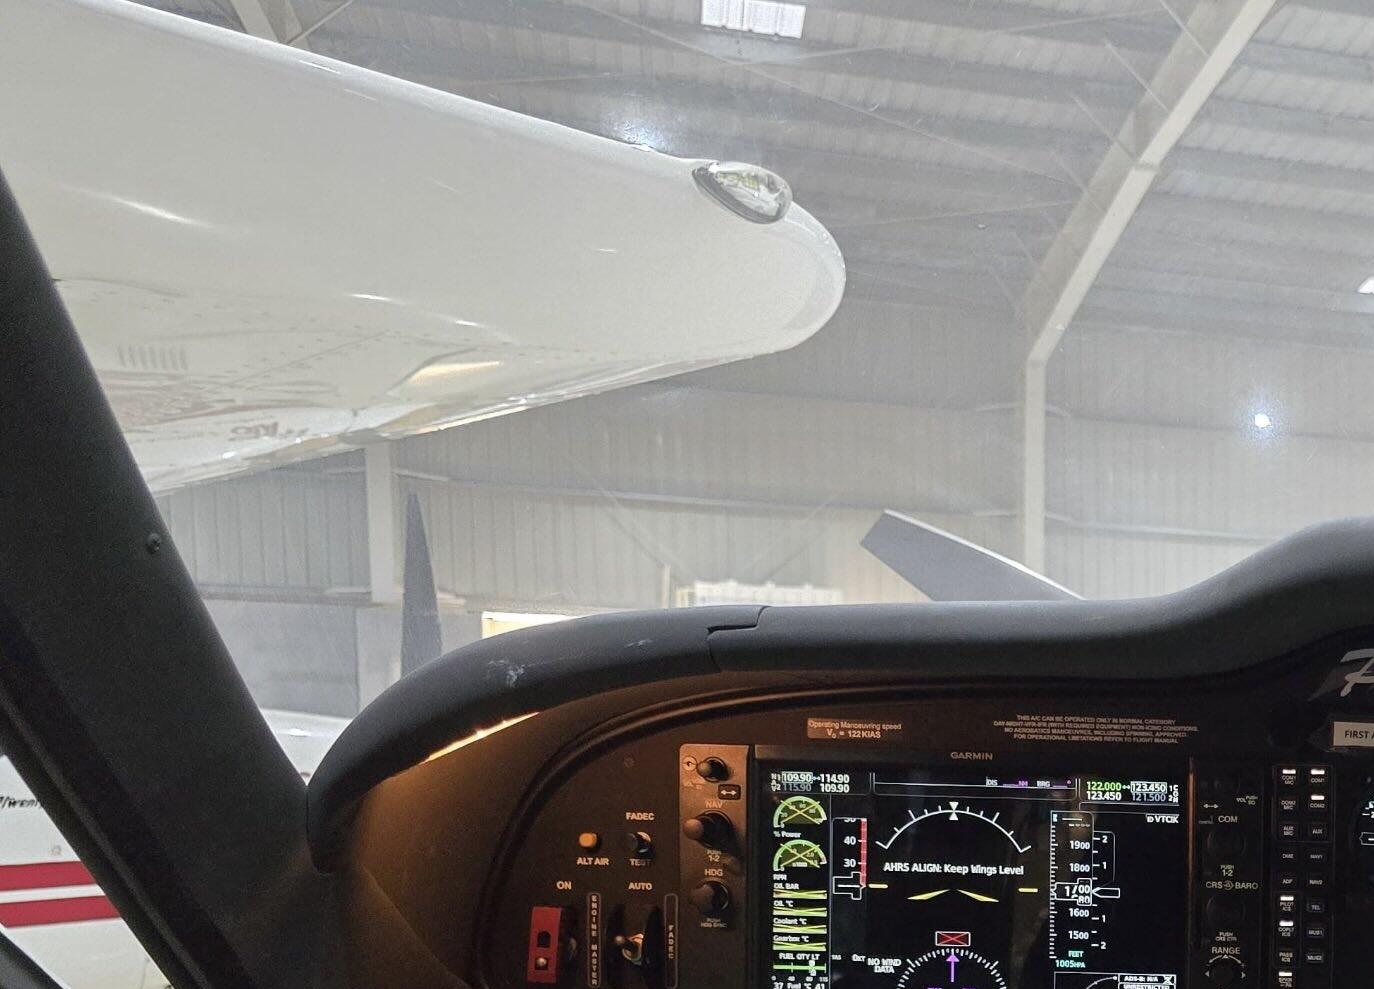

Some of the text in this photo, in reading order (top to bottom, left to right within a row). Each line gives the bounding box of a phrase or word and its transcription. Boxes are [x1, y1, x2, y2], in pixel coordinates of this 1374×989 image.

[808, 720, 839, 729] Operating
[1345, 731, 1369, 739] FIRST
[951, 752, 993, 760] GARMIN
[783, 774, 849, 783] 109.90 114.90
[821, 784, 849, 792] 109.90
[1087, 781, 1166, 792] 122.000 123.450
[1087, 791, 1166, 802] 123.450 121.500
[626, 812, 654, 820] FADEC
[1218, 815, 1238, 823] COM
[844, 837, 856, 845] 40
[1070, 841, 1090, 849] 1900
[844, 859, 856, 867] 30
[884, 863, 909, 872] AHRS
[944, 865, 968, 875] Keep
[971, 866, 997, 875] Wings
[999, 866, 1024, 875] Level
[1070, 863, 1090, 872] 1800
[557, 881, 572, 890] ON
[1069, 908, 1089, 917] 1600
[1068, 931, 1089, 939] 1500
[868, 958, 880, 966] NO
